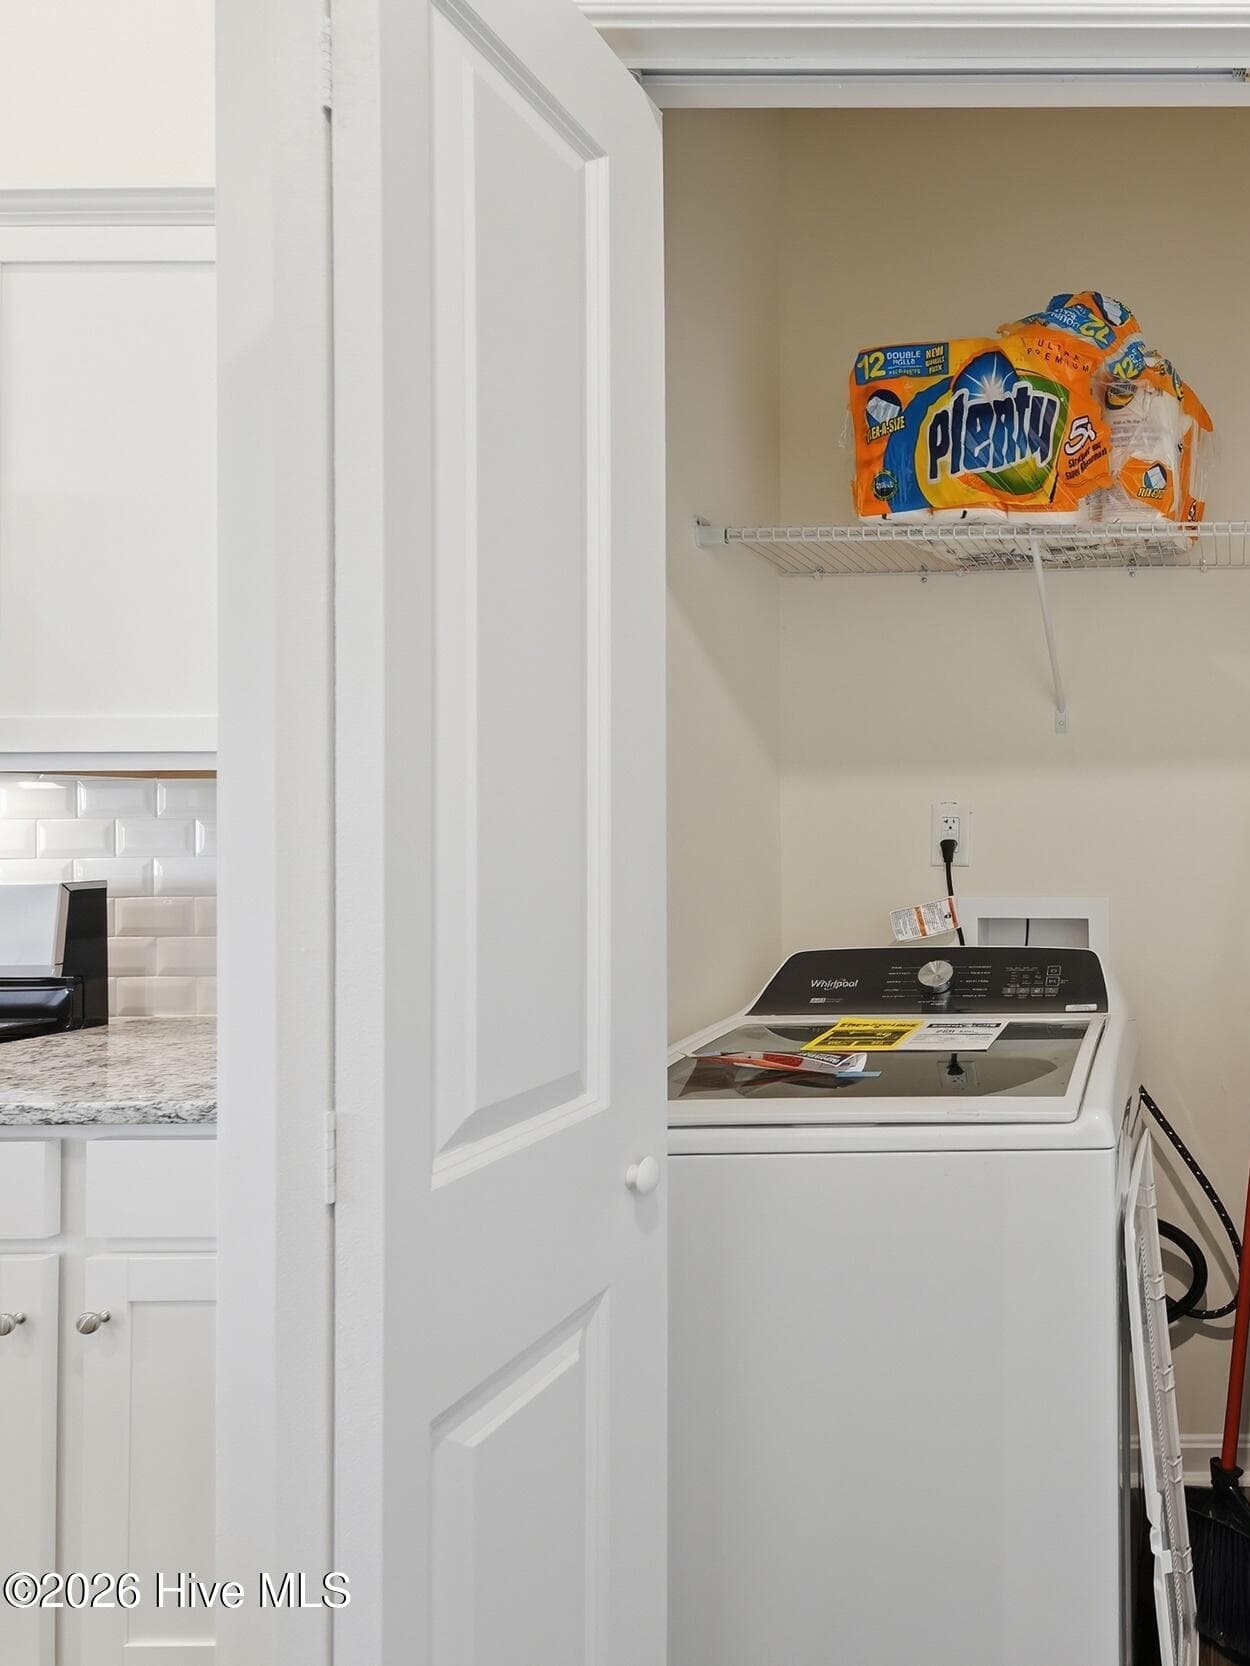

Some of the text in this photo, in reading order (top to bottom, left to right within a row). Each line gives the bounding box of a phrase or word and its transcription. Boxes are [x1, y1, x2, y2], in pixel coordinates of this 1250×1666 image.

[886, 350, 921, 360] DOUBLE
[925, 345, 945, 359] NEW
[1027, 347, 1090, 373] PREMIUM
[1038, 338, 1079, 362] ULTRA
[856, 351, 887, 381] 12
[1113, 356, 1139, 380] 12
[928, 383, 1058, 482] plenty
[811, 979, 859, 990] Whirlpool
